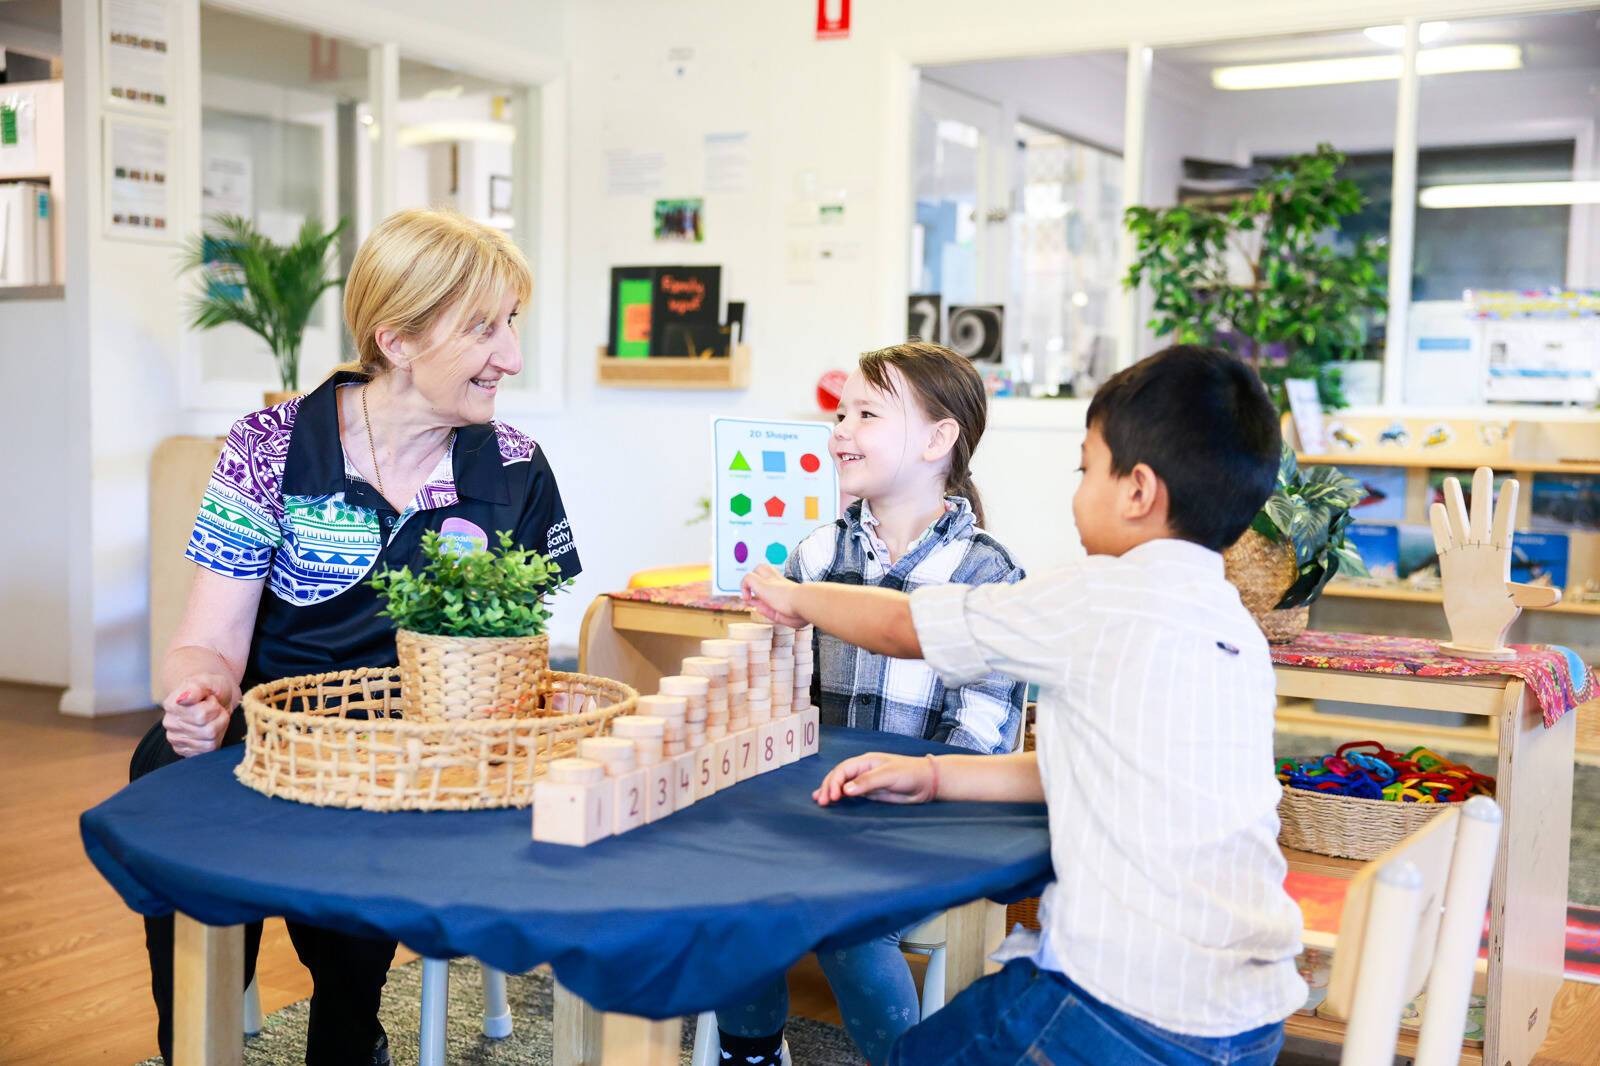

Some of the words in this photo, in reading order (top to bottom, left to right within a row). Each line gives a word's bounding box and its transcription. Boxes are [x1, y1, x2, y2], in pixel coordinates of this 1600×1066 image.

[749, 430, 762, 438] 2D
[766, 430, 798, 440] Shapes
[547, 530, 570, 548] early
[786, 729, 794, 752] 9
[803, 721, 815, 747] 10
[742, 742, 751, 768] 7
[765, 736, 774, 761] 8
[701, 758, 710, 785] 5
[722, 749, 730, 775] 6
[657, 778, 667, 806] 3
[680, 767, 690, 792] 4
[629, 787, 639, 817] 2
